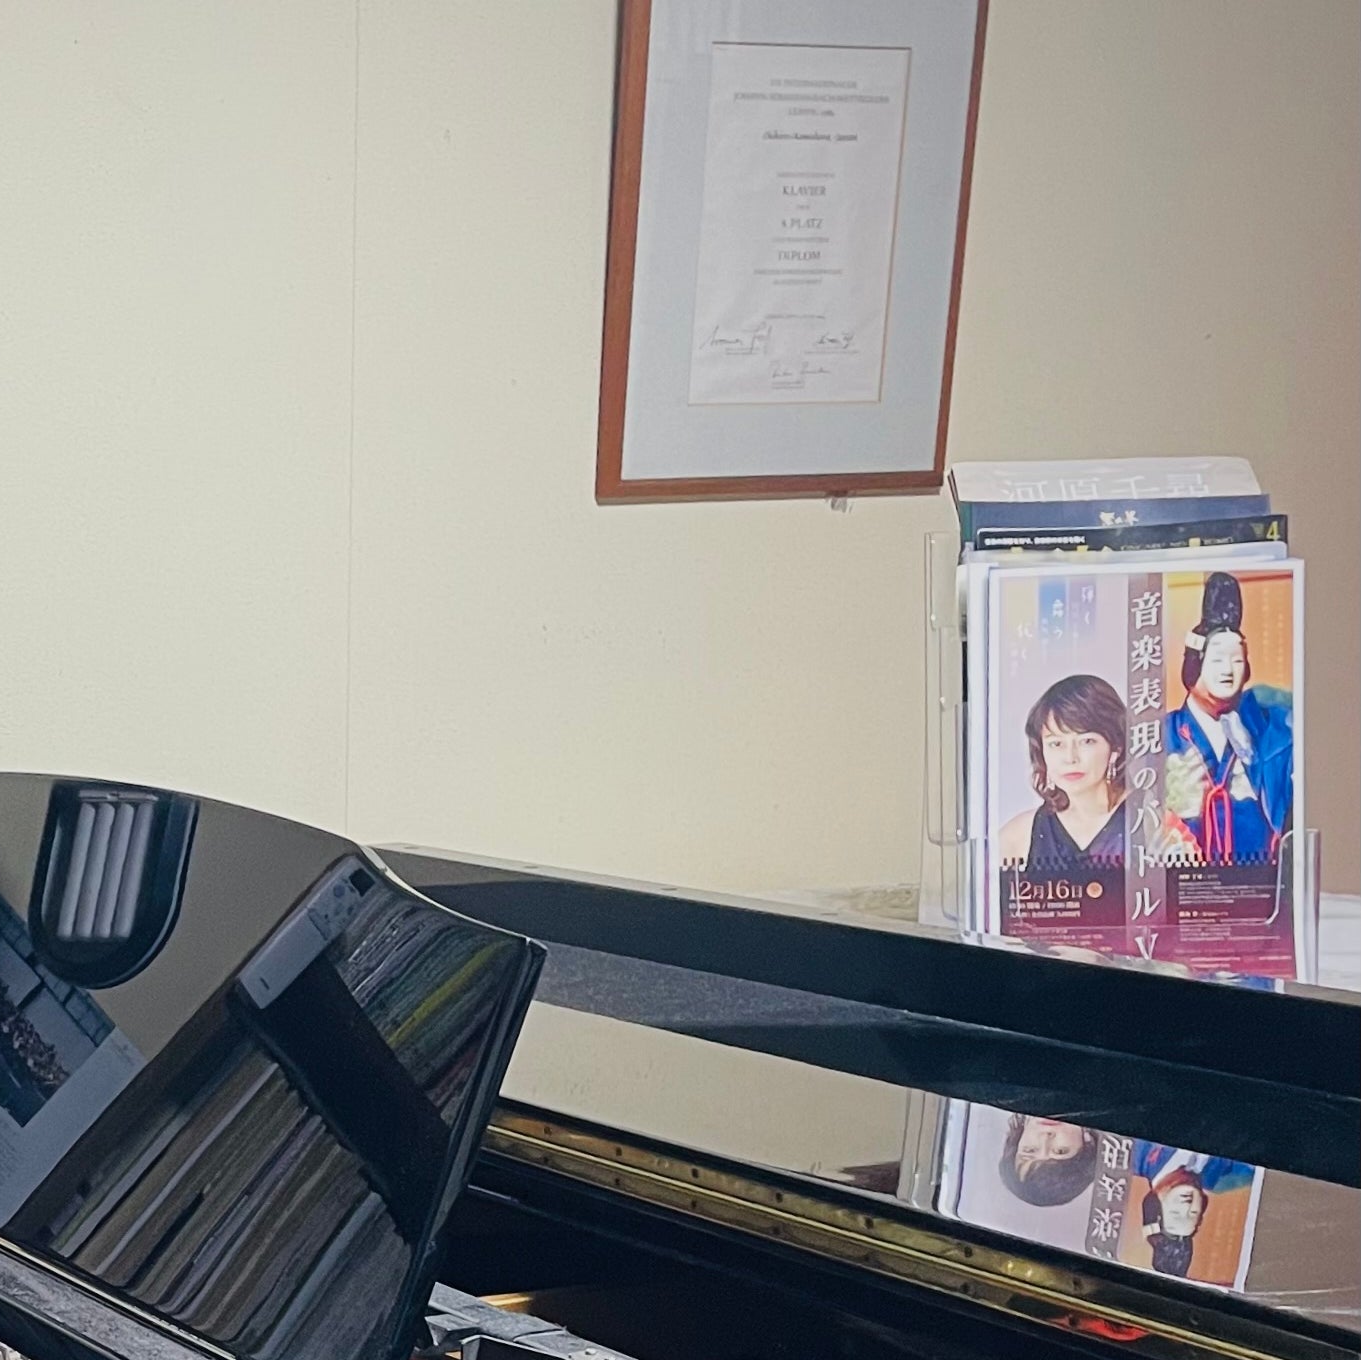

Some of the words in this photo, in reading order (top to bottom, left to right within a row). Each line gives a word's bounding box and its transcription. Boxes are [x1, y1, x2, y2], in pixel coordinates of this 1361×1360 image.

[782, 185, 827, 196] KLAVIER
[789, 218, 825, 229] PLATZ
[777, 250, 822, 261] DIPLOM
[1265, 520, 1281, 542] 4
